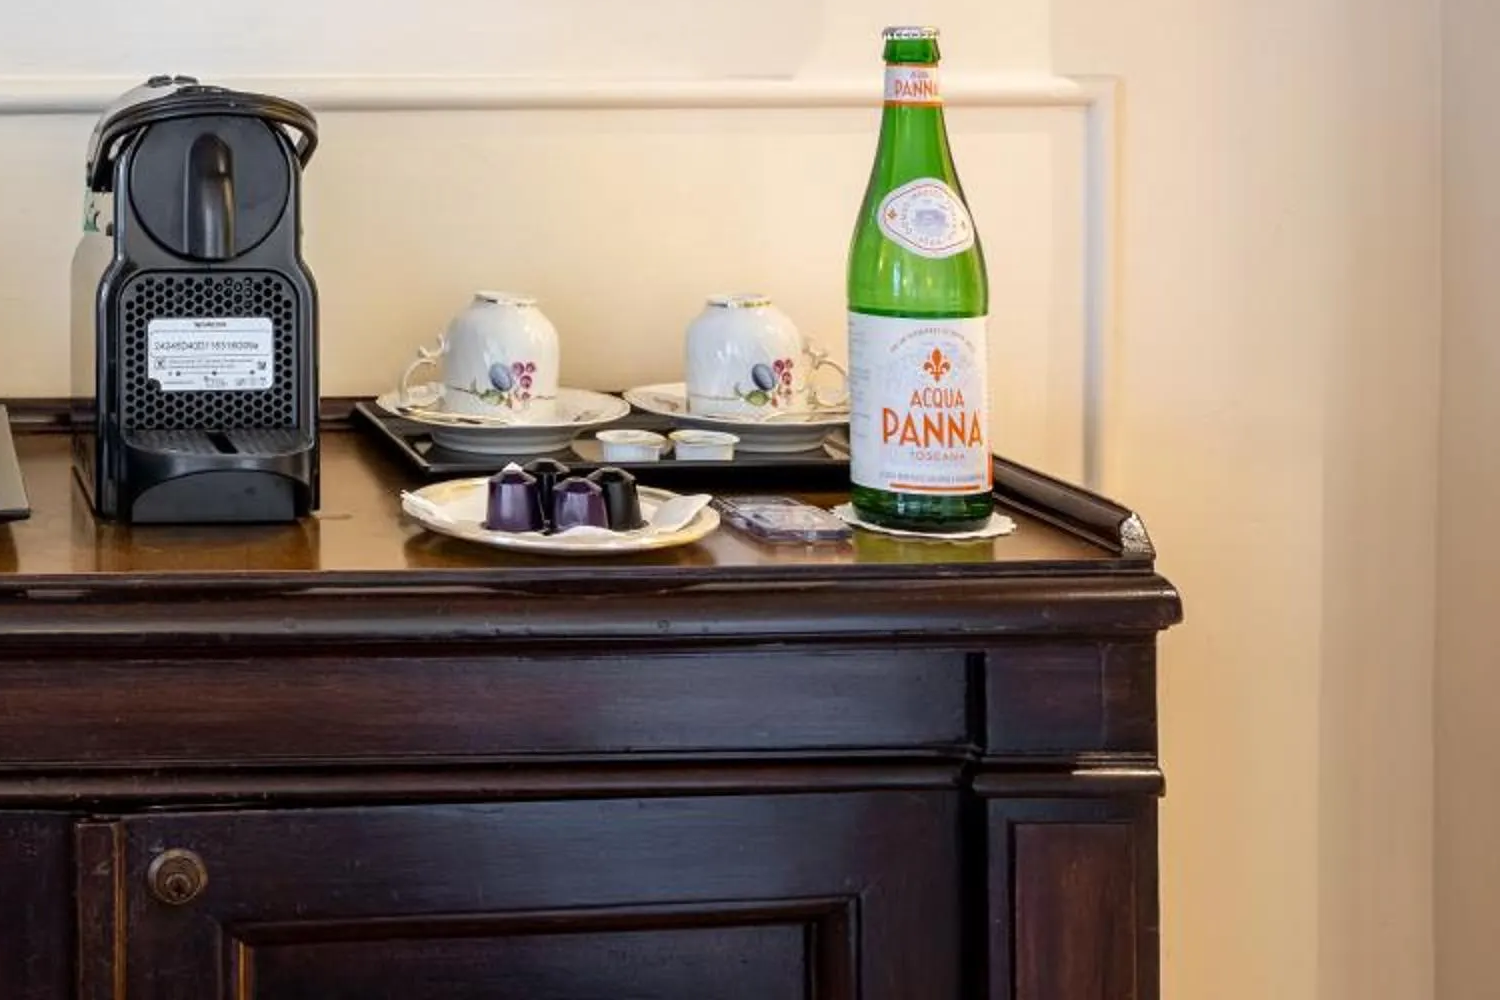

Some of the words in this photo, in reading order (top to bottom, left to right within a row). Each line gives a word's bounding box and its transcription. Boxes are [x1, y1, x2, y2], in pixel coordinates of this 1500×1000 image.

[910, 387, 965, 408] ACQUA
[882, 407, 984, 448] PANNA
[909, 449, 965, 461] TOSCANA
